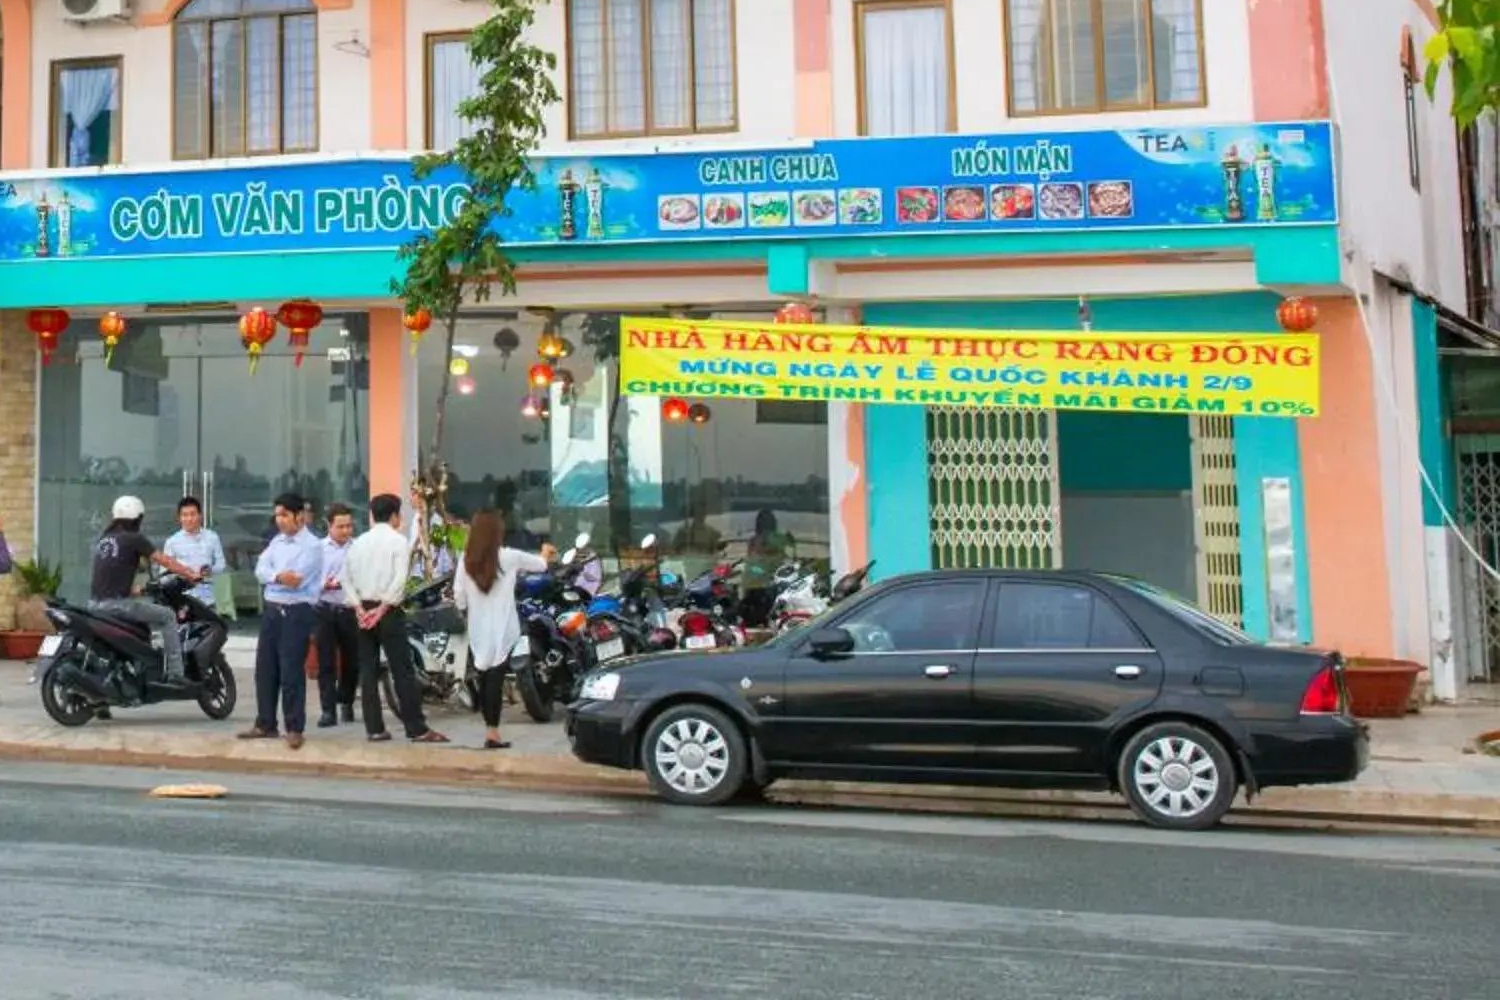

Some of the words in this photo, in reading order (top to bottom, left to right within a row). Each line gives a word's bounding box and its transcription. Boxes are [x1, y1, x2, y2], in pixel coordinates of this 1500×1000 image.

[1138, 133, 1188, 153] TEA
[700, 157, 767, 185] CANH
[771, 154, 839, 182] CHUA
[952, 140, 1009, 175] MÓN
[1015, 139, 1073, 180] MẶN
[110, 189, 203, 242] CƠM
[211, 180, 303, 239] VĂN
[627, 324, 707, 350] NHÀ
[724, 329, 836, 354] HÀNG
[924, 337, 1041, 363] THỰC
[1190, 338, 1314, 368] ĐÔNG
[948, 364, 1048, 385] QUỐC
[1202, 374, 1254, 392] 2/9
[1240, 400, 1316, 416] 10%
